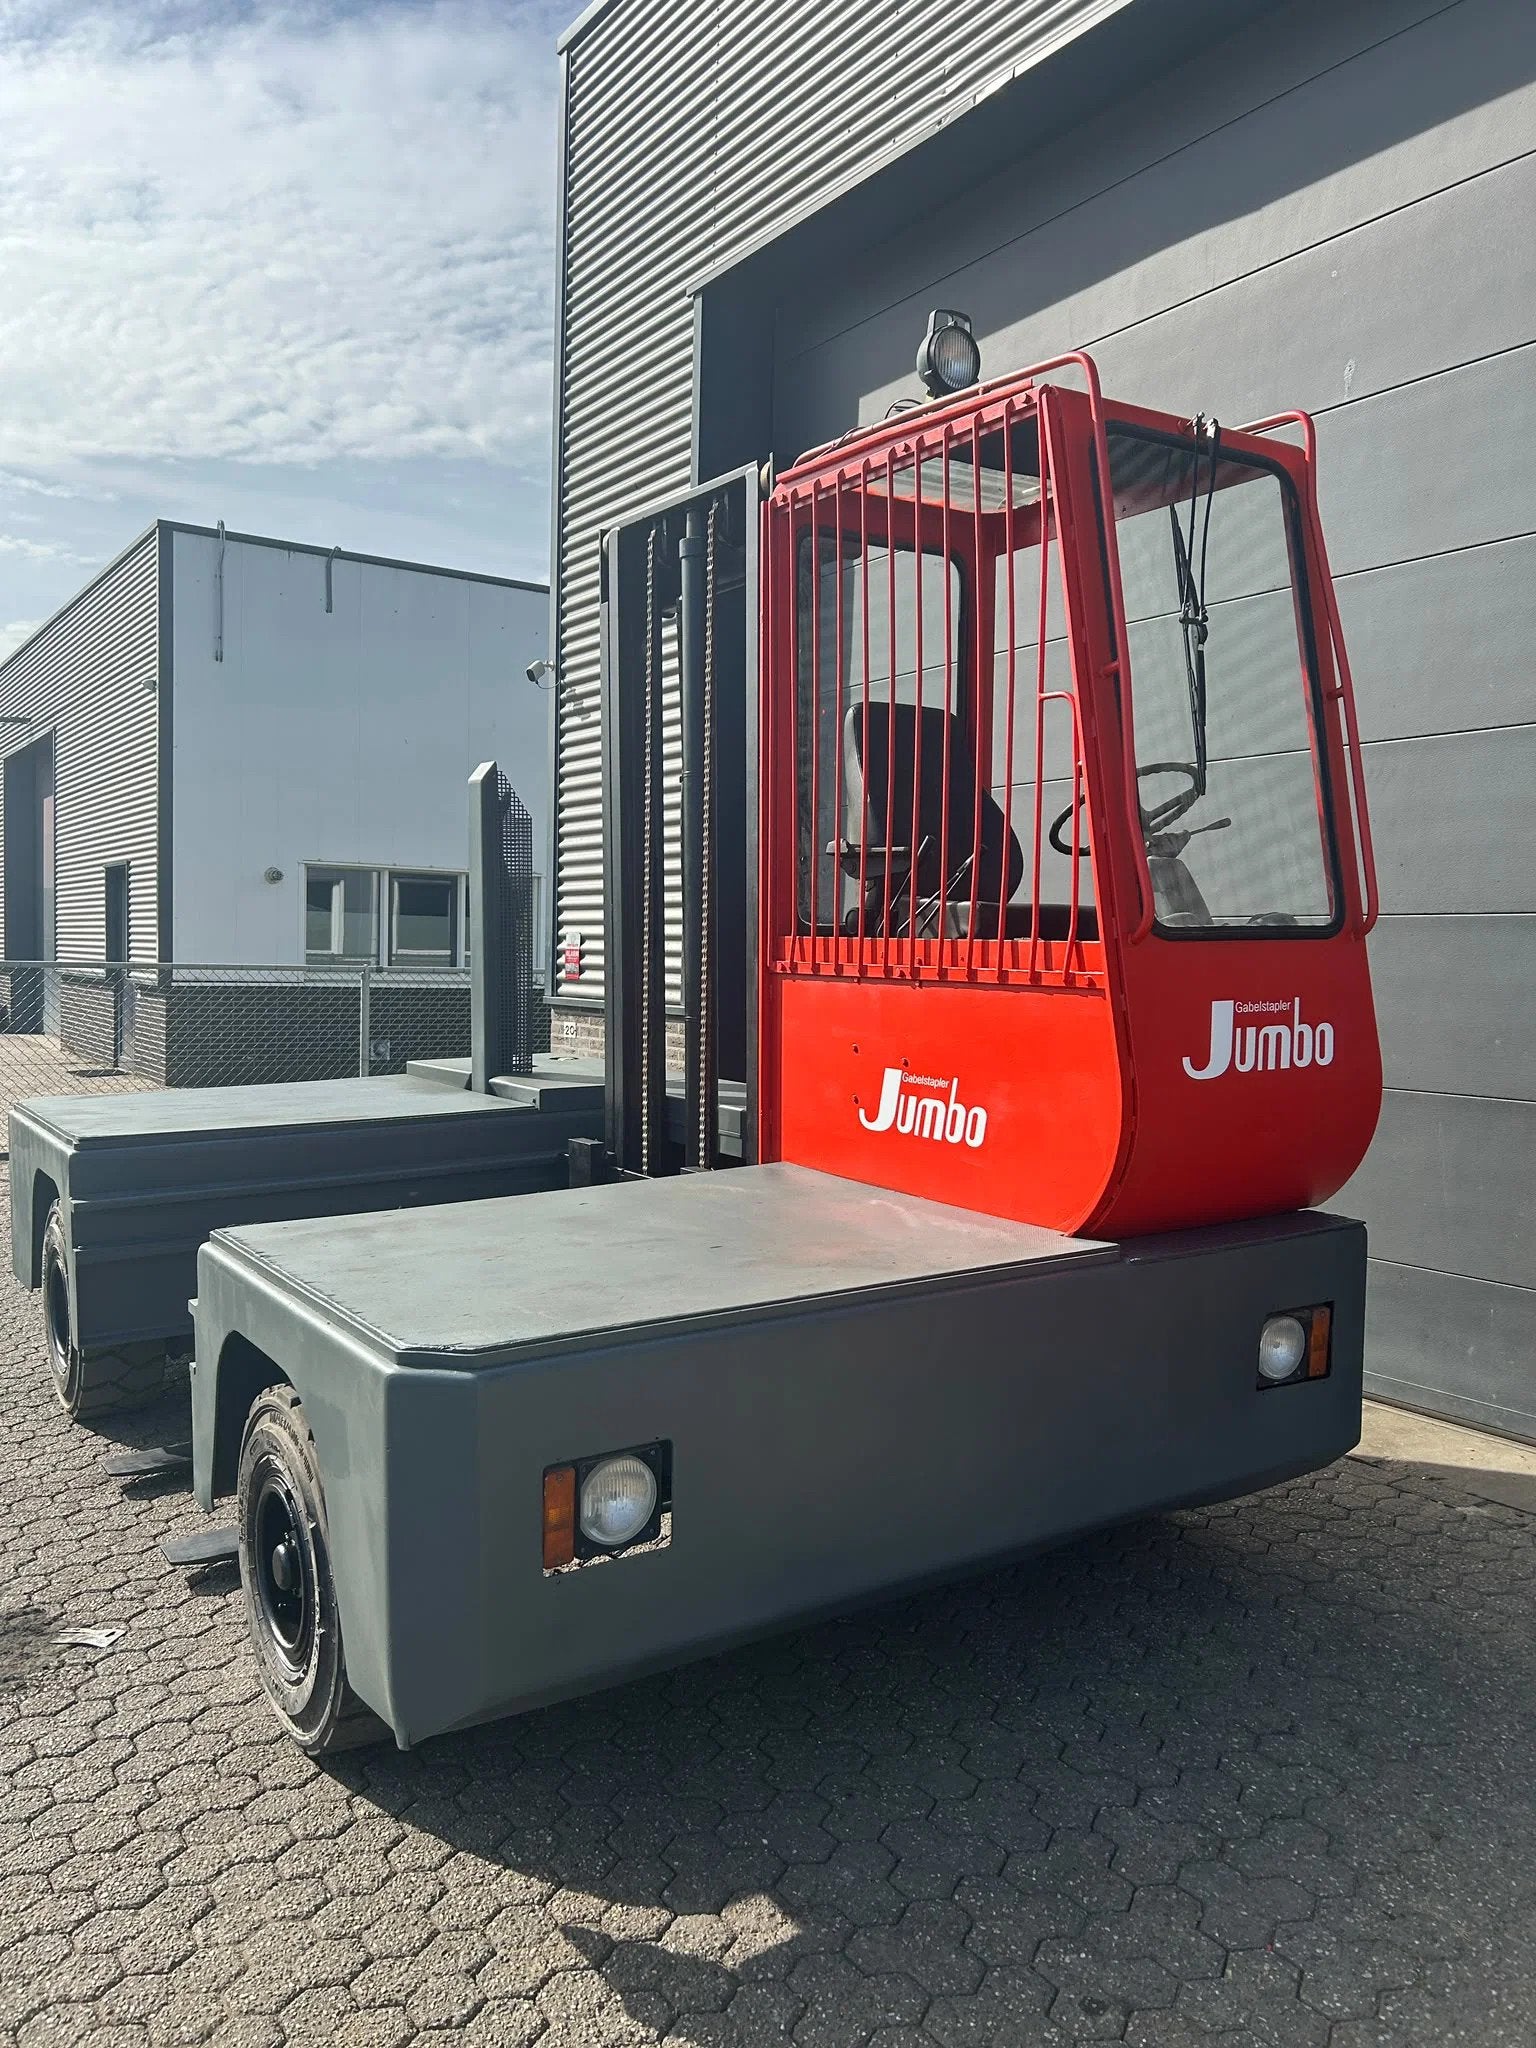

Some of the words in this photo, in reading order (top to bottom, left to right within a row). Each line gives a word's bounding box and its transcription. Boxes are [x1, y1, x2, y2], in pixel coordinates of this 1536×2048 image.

[1235, 1000, 1292, 1013] Gabelstapler
[1182, 996, 1334, 1080] Jumbo
[902, 1072, 950, 1089] Gabelstapler
[858, 1067, 988, 1148] Jumbo
